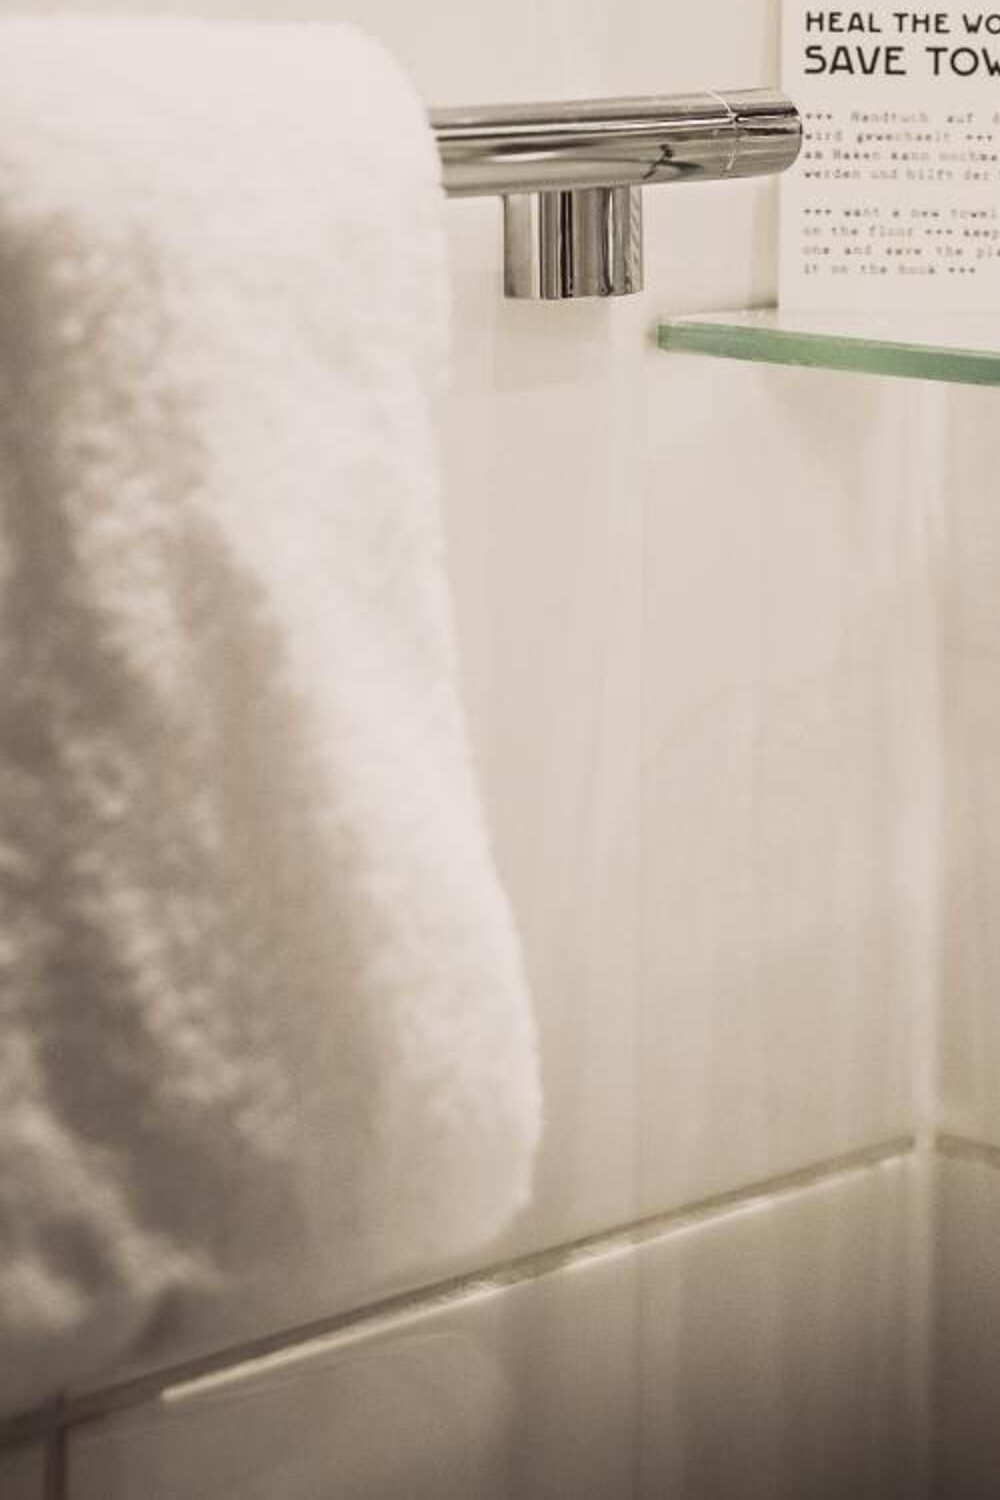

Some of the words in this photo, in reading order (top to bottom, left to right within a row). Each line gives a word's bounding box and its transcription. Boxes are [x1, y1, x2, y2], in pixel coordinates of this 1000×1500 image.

[805, 11, 882, 33] HEAL
[893, 12, 950, 34] THE
[803, 45, 907, 76] SAVE
[850, 111, 929, 124] Handtuch
[803, 168, 861, 180] werden
[870, 168, 897, 180] und
[843, 207, 880, 218] want
[831, 225, 859, 237] the
[868, 224, 914, 237] floor
[963, 228, 1000, 241] keep
[802, 245, 830, 256] one
[844, 244, 872, 256] and
[886, 246, 923, 256] save
[935, 245, 963, 257] the
[860, 263, 888, 275] the
